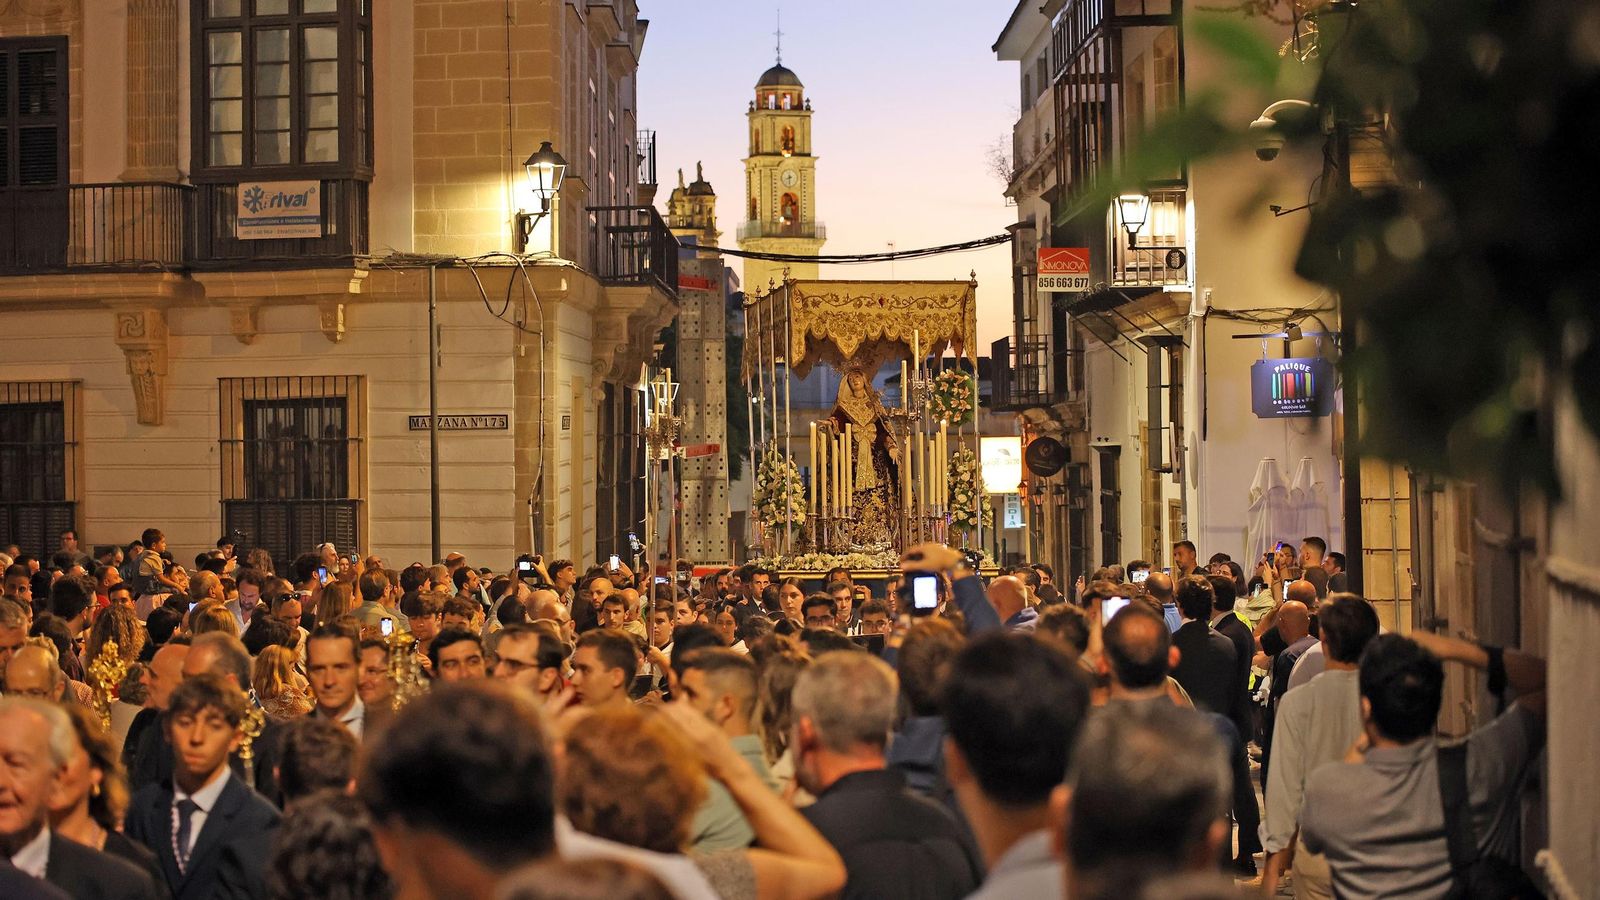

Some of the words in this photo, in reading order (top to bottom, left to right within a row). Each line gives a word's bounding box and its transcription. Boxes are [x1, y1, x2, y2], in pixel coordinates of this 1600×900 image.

[1039, 277, 1055, 288] 856
[1057, 277, 1072, 288] 663
[1074, 277, 1089, 288] 677
[1274, 362, 1312, 373] PALIQUE
